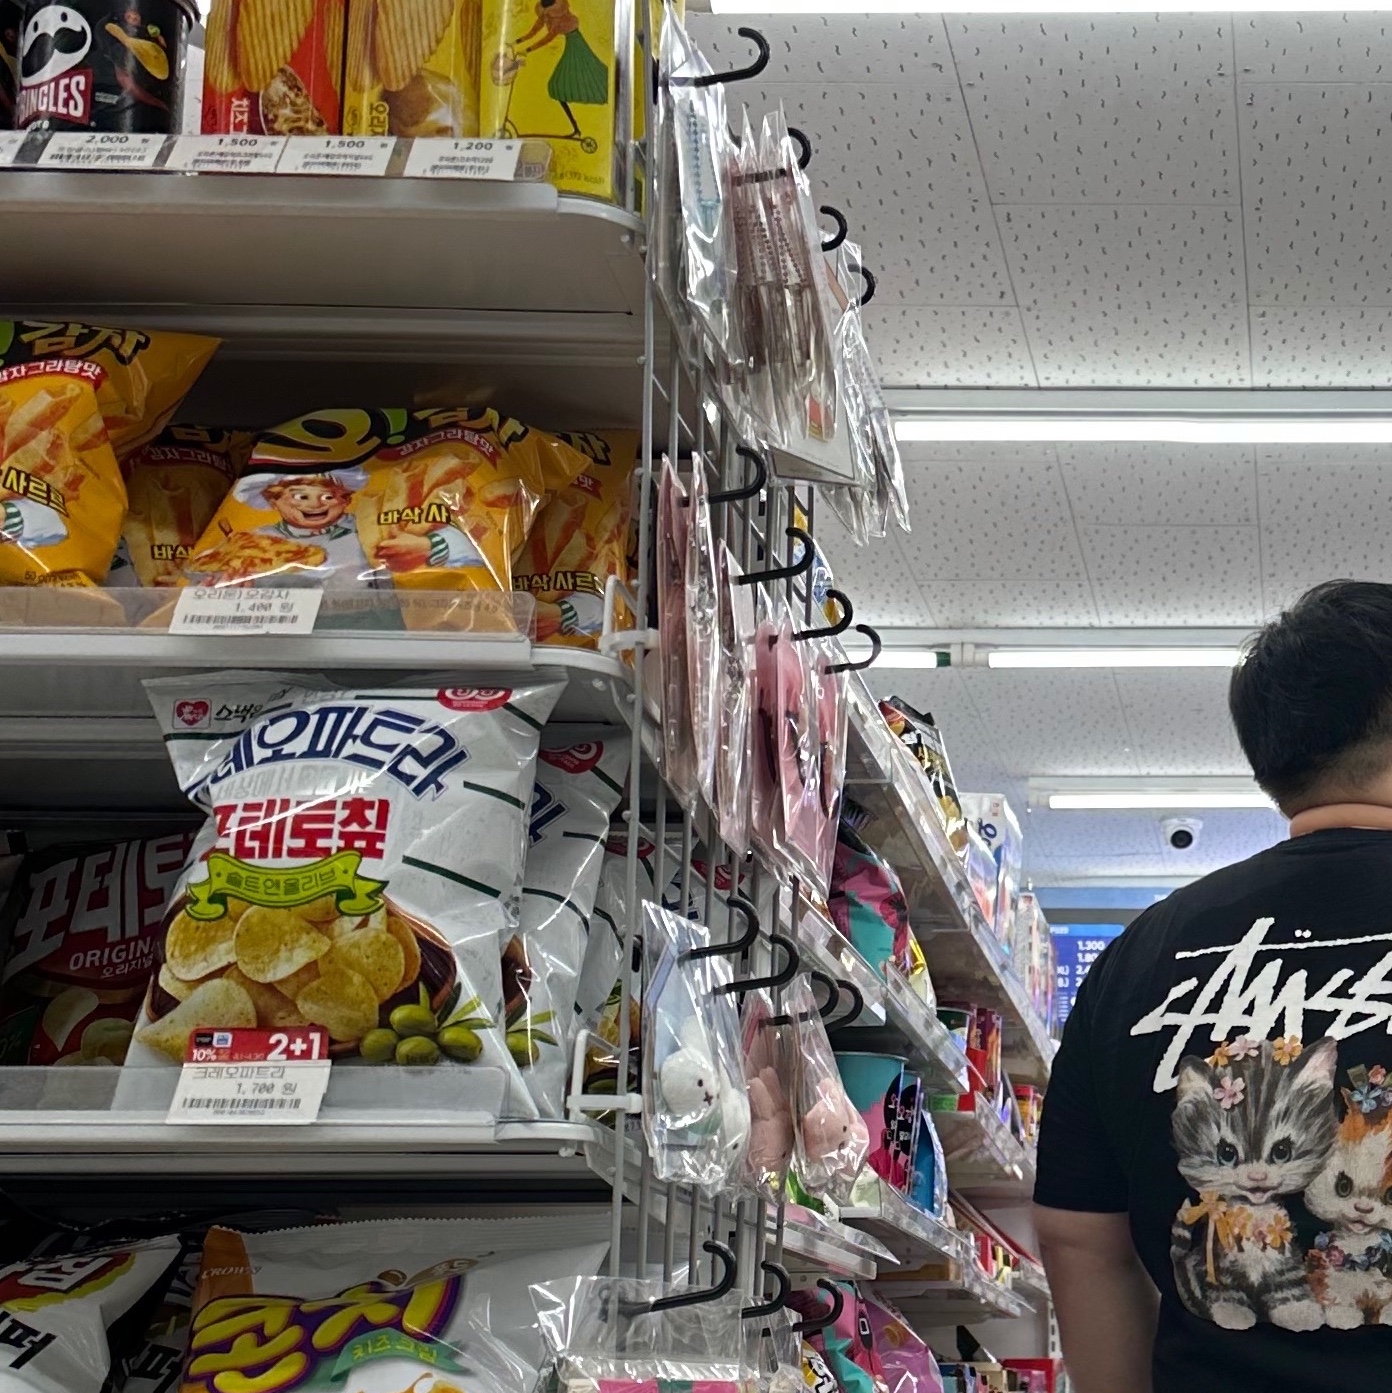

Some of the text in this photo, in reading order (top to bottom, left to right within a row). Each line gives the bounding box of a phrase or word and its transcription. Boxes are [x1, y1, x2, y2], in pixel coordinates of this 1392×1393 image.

[19, 75, 86, 121] RINGLES
[86, 135, 129, 144] 2,000
[217, 137, 258, 147] 1,500
[325, 140, 365, 149] 1,500
[453, 141, 493, 151] 1,200
[20, 320, 150, 365] 감자
[380, 506, 424, 526] 바삭
[3, 832, 190, 986] 포테토
[69, 935, 166, 972] ORIGIN
[266, 1032, 321, 1062] 2+1
[236, 1082, 298, 1095] 1,700 원
